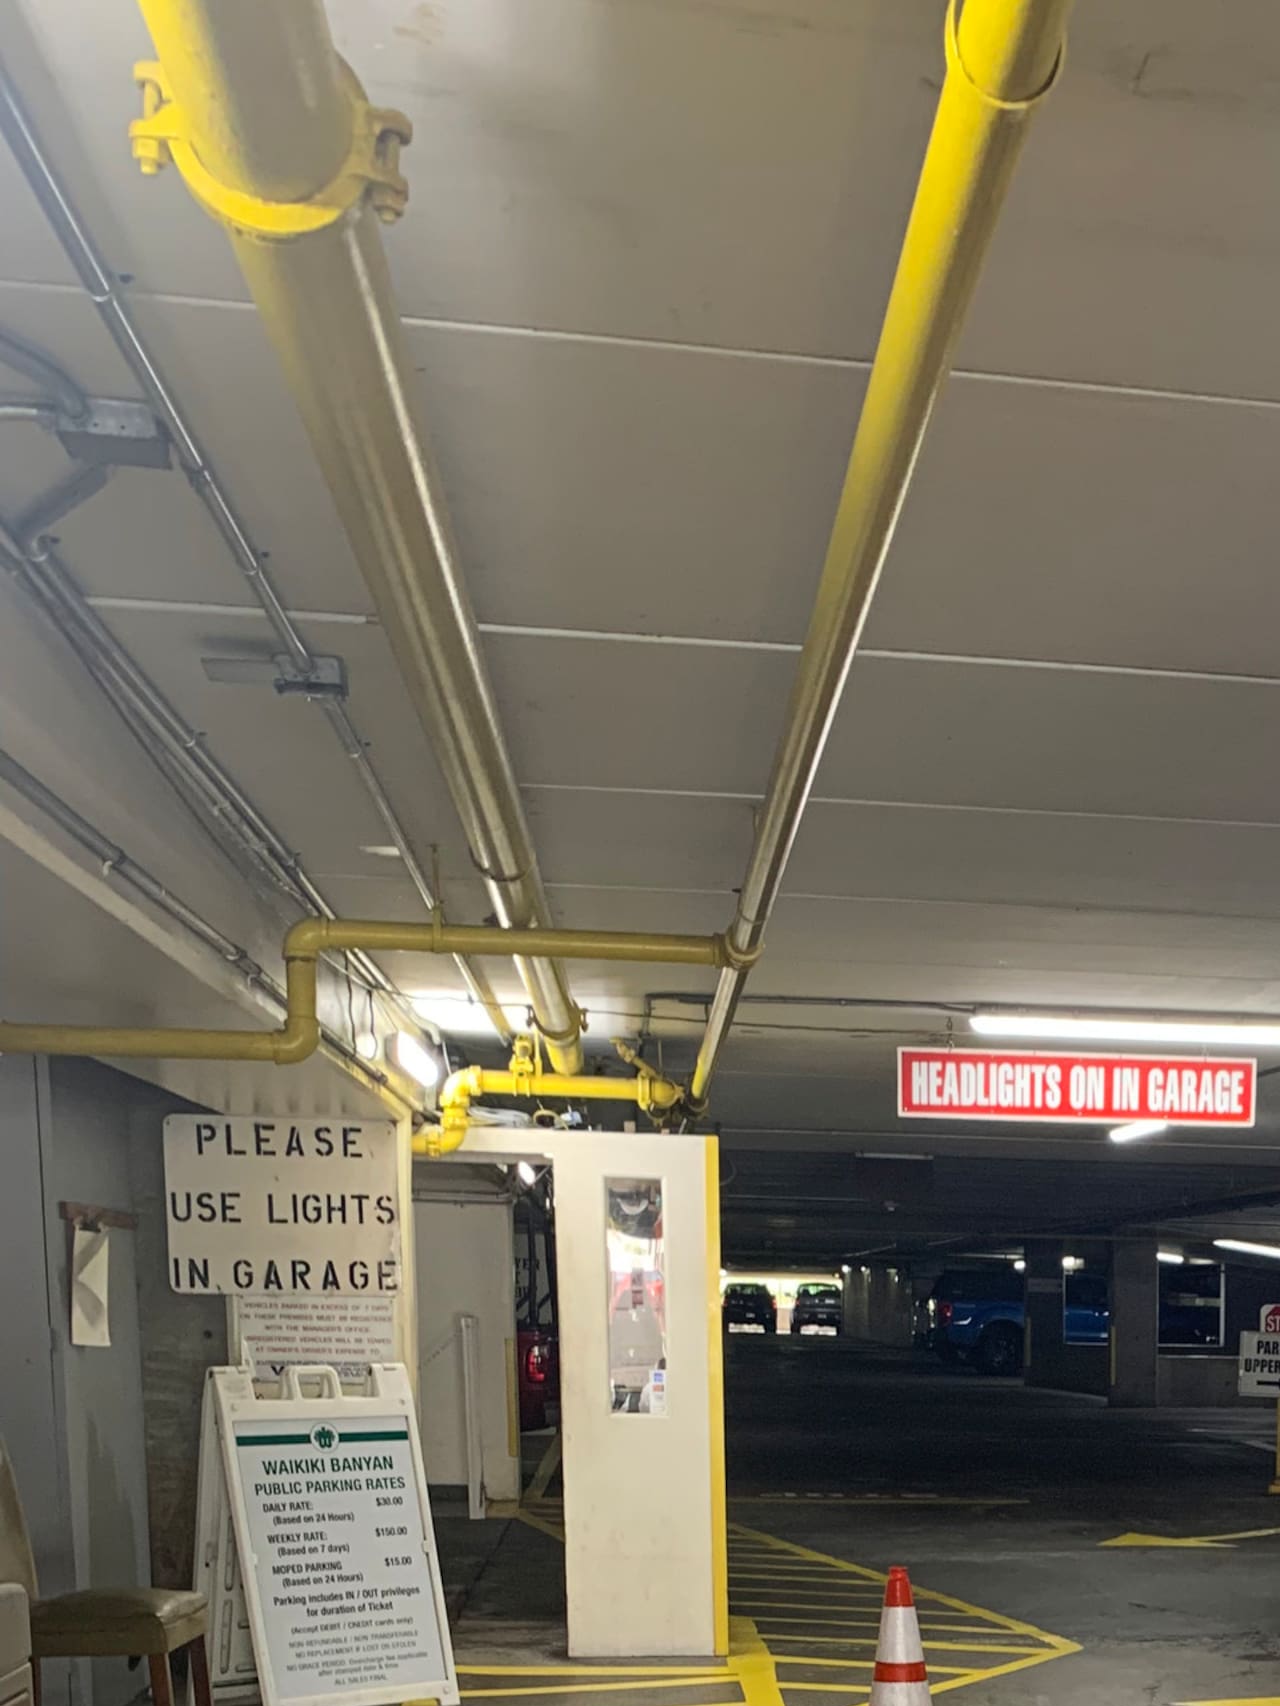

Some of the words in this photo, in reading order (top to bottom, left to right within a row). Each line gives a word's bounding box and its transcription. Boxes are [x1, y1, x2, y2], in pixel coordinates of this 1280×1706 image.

[911, 1061, 1061, 1109] HEADLIGHTS
[1070, 1065, 1104, 1110] ON
[1113, 1068, 1139, 1111] IN
[1148, 1069, 1244, 1114] GARAGE
[196, 1124, 362, 1158] PLEASE
[171, 1192, 241, 1223] USE
[268, 1194, 395, 1224] LIGHTS
[173, 1258, 209, 1288] IN
[233, 1260, 398, 1290] GARAGE
[262, 1458, 326, 1475] WAIKIKI
[331, 1456, 394, 1472] BANYAN
[255, 1482, 303, 1496] PUBLIC
[307, 1478, 362, 1493] PARKING
[366, 1477, 405, 1490] RATES
[263, 1502, 287, 1513] DAILY
[289, 1501, 313, 1511] RATE:
[376, 1496, 403, 1507] $30.00
[273, 1516, 302, 1527] (Based
[304, 1514, 314, 1523] on
[316, 1513, 326, 1522] 24
[328, 1512, 355, 1522] Hours)
[267, 1533, 301, 1544] WEEKLY
[303, 1531, 328, 1542] RATE:
[375, 1526, 408, 1537] $150.00
[278, 1546, 307, 1558] (Based
[308, 1544, 319, 1554] on
[321, 1544, 326, 1553] 7
[328, 1543, 350, 1553] days)
[272, 1564, 303, 1575] MOPED
[305, 1561, 342, 1573] PARKING
[384, 1556, 412, 1567] $15.00
[282, 1576, 311, 1588] (Based
[313, 1575, 323, 1584] on
[325, 1575, 336, 1584] 24
[337, 1572, 364, 1583] Hours)
[273, 1595, 307, 1606] Parking
[309, 1591, 344, 1604] includes
[345, 1591, 355, 1600] IN
[362, 1589, 378, 1599] OUT
[381, 1586, 420, 1599] privileges
[307, 1607, 318, 1617] for
[321, 1603, 356, 1616] duration
[358, 1602, 366, 1613] of
[368, 1601, 393, 1612] Ticket
